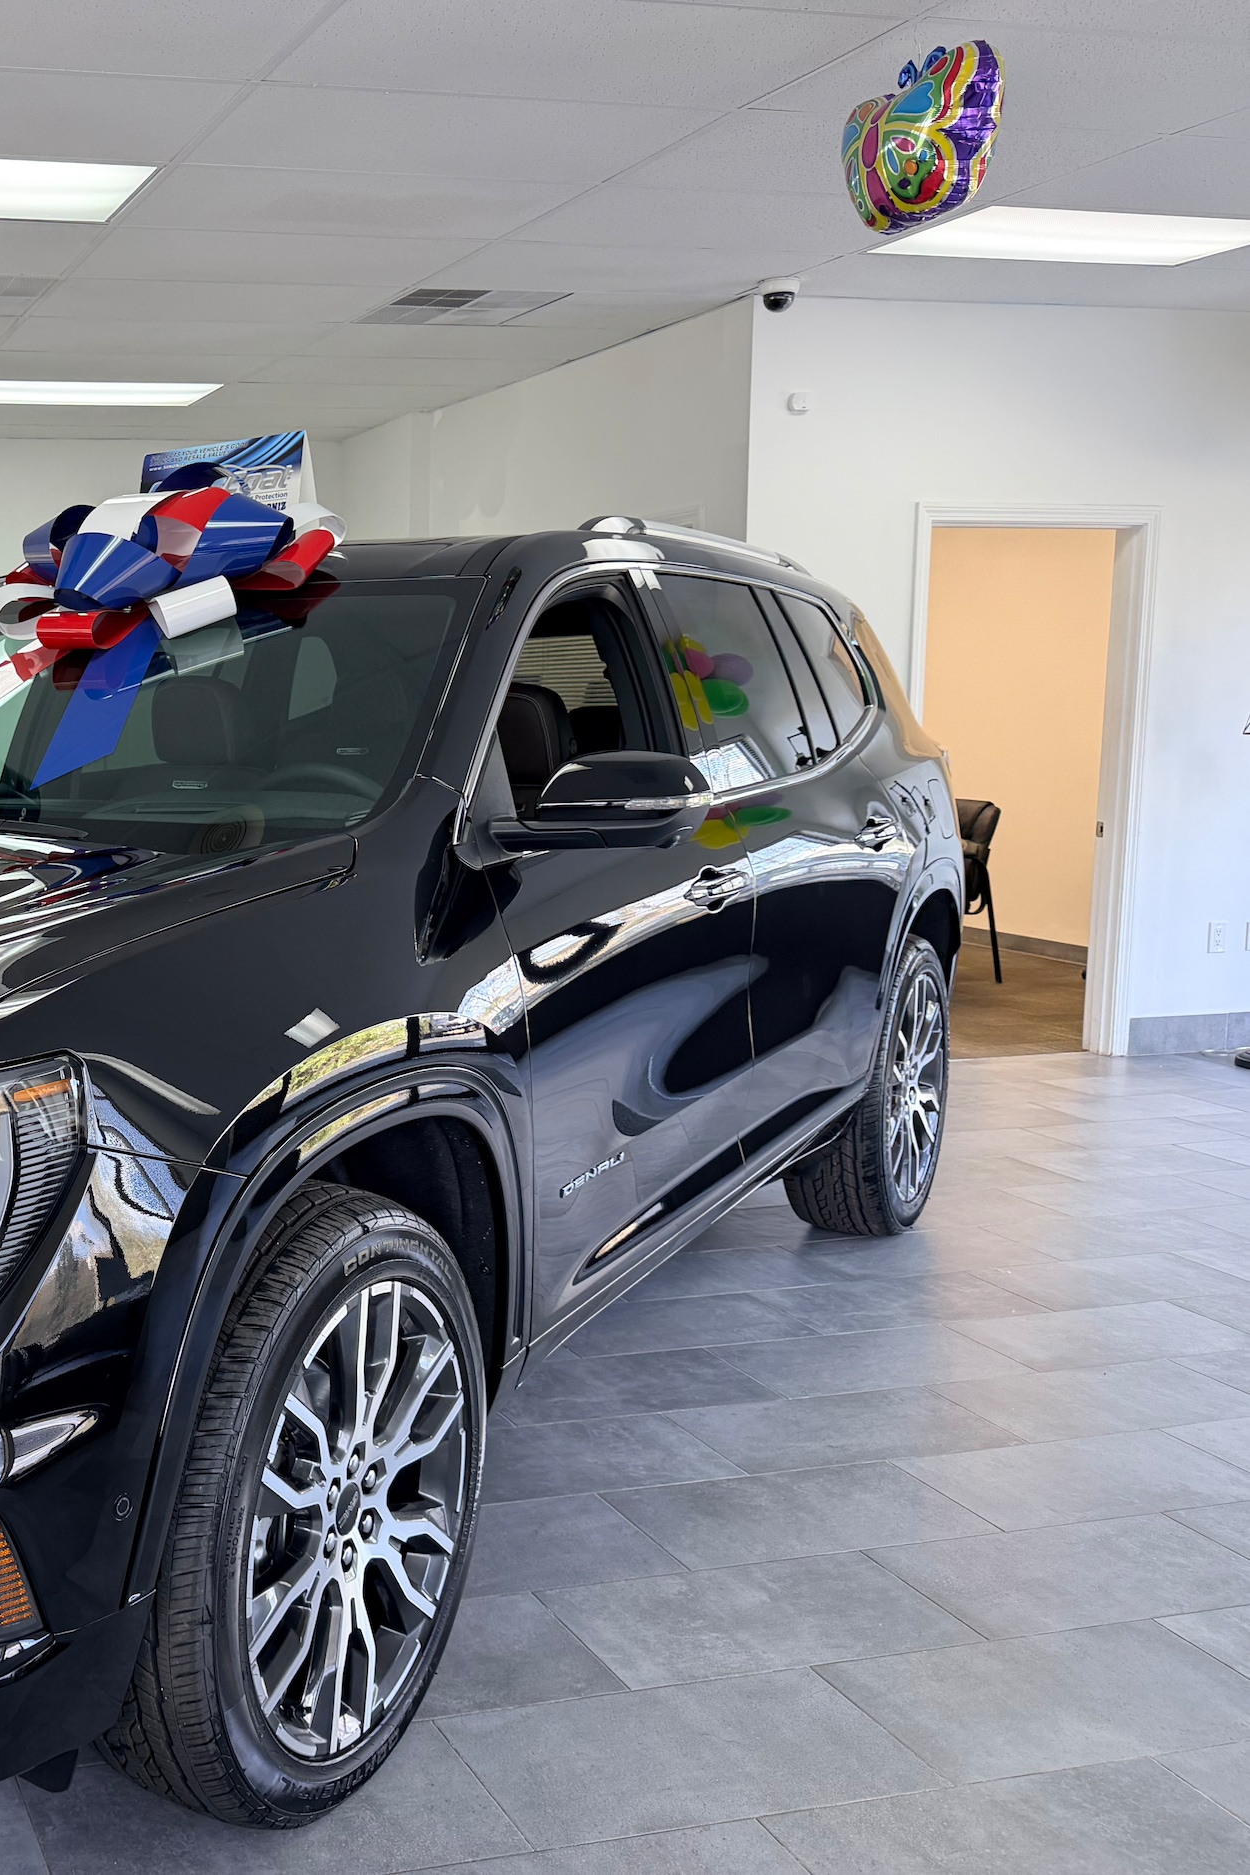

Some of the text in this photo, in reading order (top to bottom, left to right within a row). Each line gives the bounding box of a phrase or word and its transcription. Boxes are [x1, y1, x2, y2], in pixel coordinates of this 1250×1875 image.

[255, 492, 288, 501] Protection
[559, 1151, 625, 1199] DENALI
[343, 1237, 452, 1280] CONTINENTAL
[338, 1490, 358, 1528] GMC
[281, 1727, 400, 1800] CONTINENTAL
